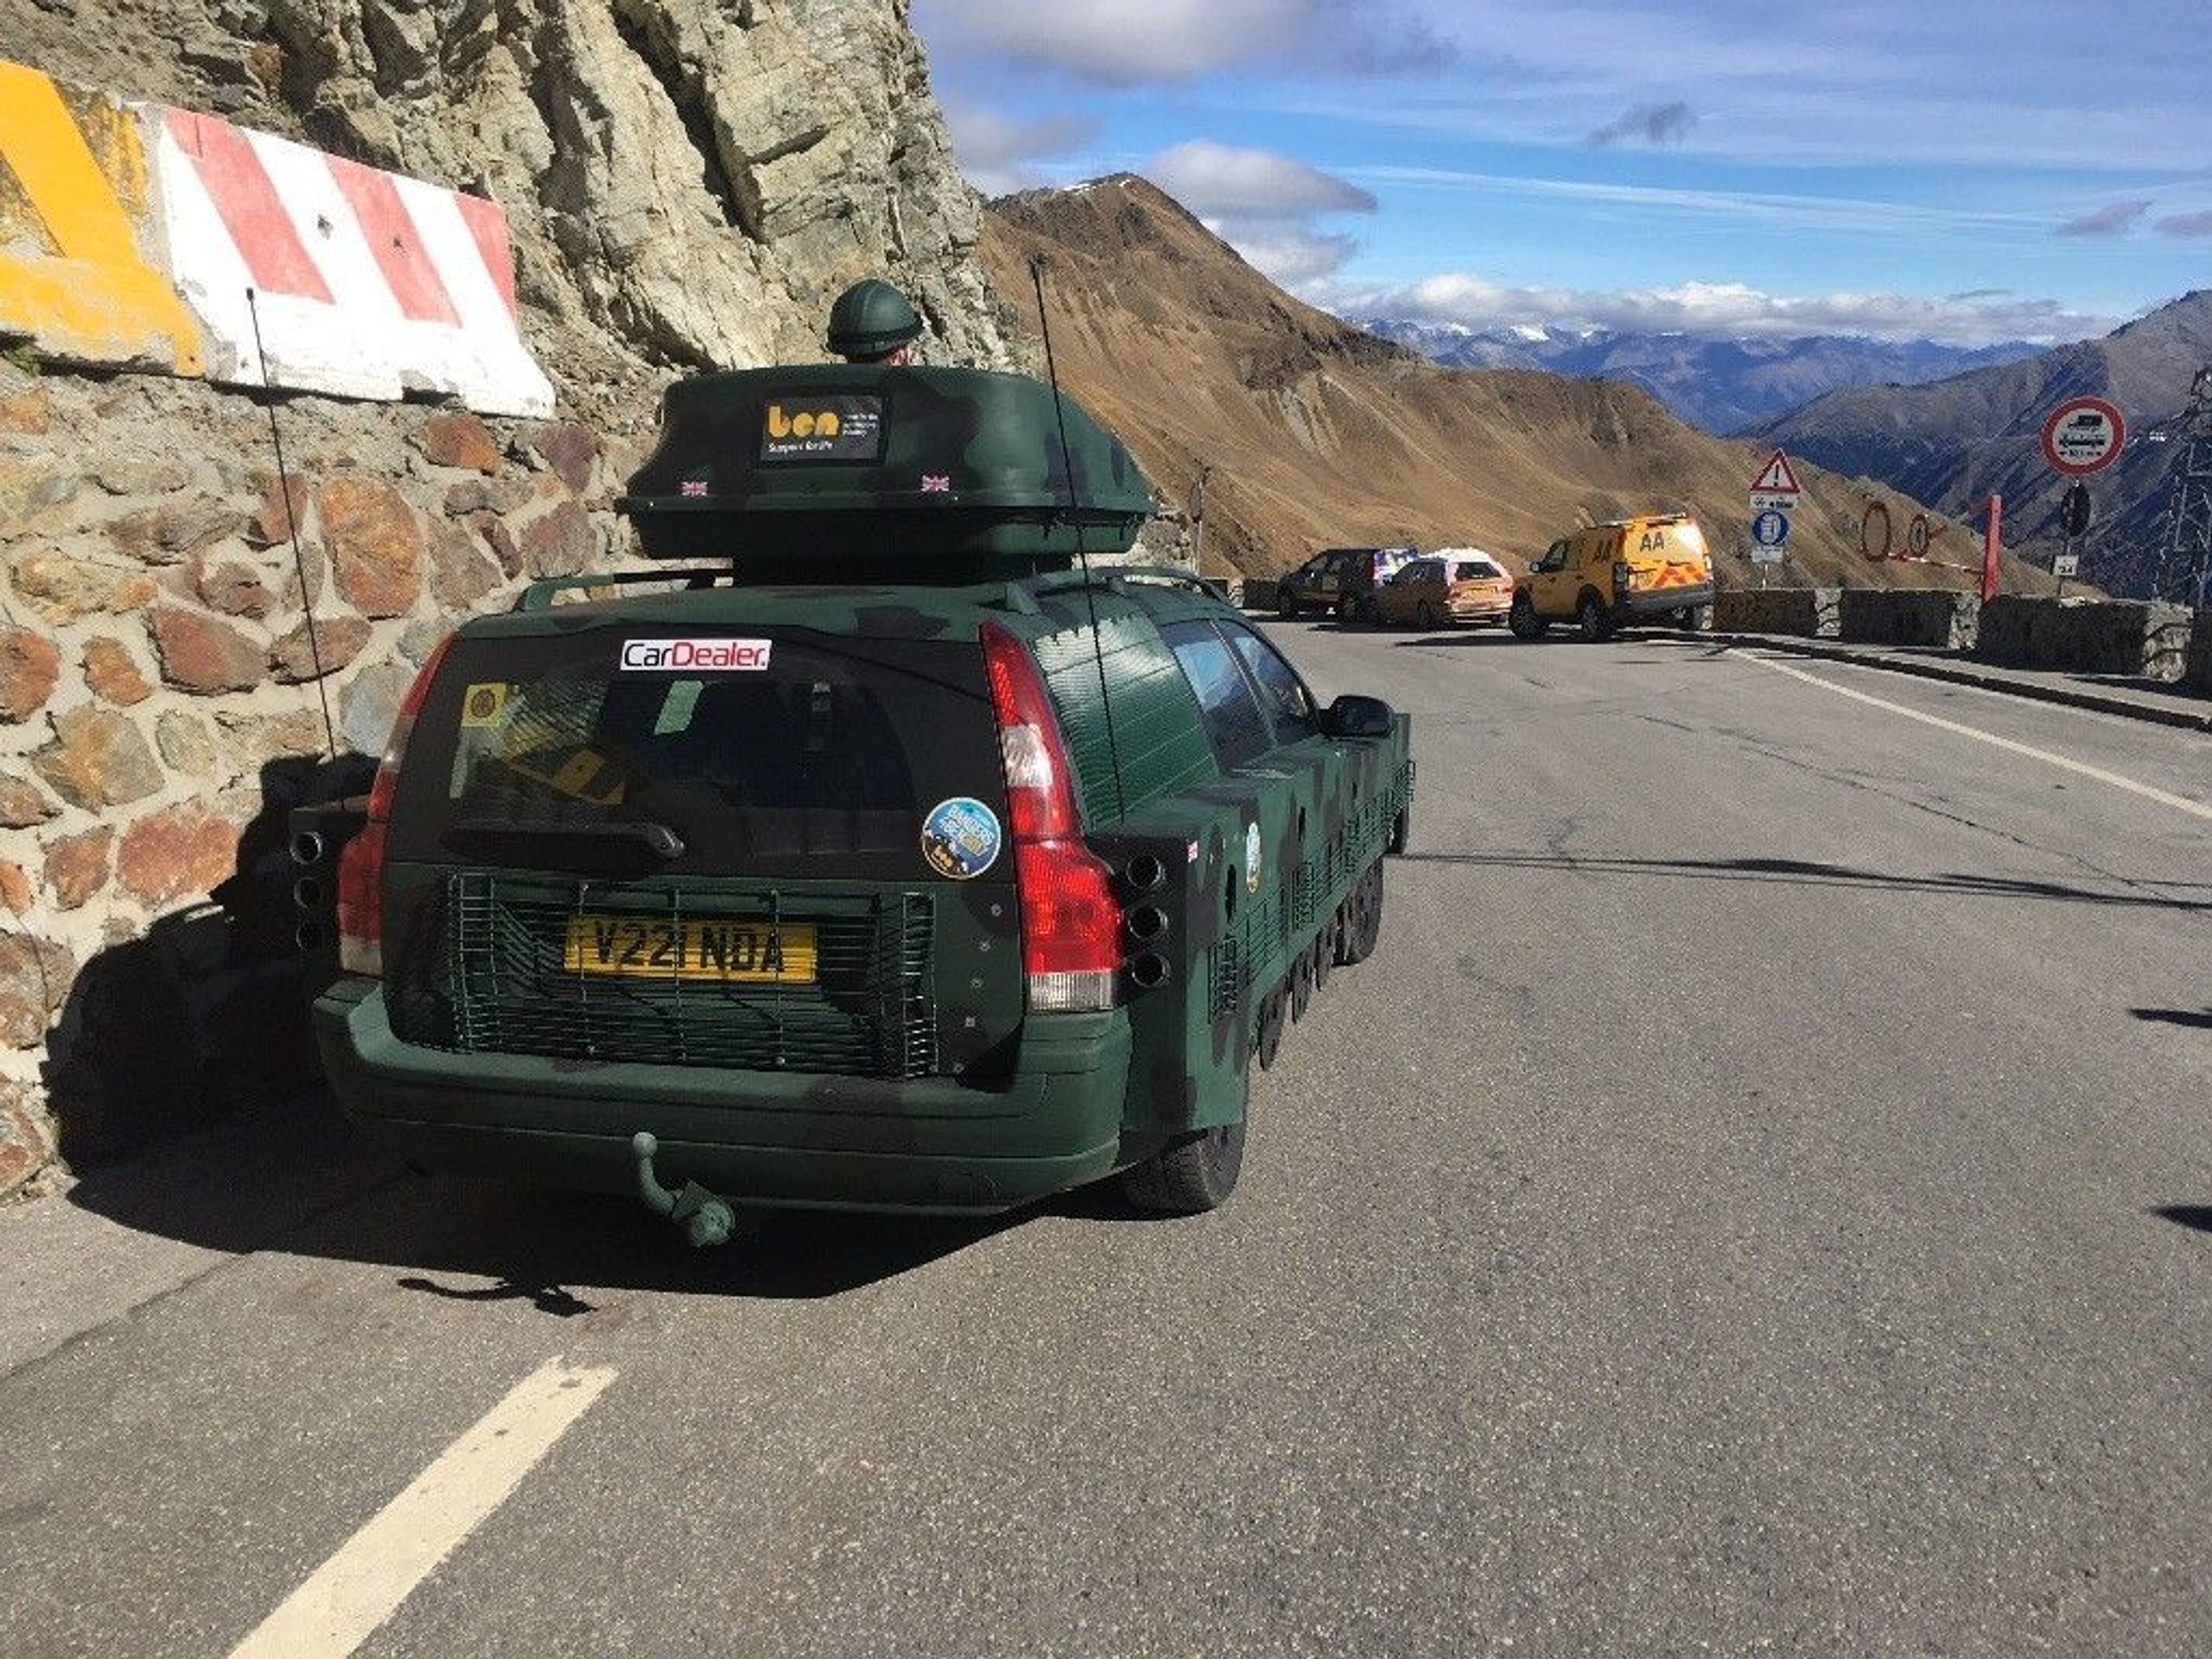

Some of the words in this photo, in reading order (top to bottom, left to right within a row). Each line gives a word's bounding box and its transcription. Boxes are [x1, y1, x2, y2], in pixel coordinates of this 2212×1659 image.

[768, 405, 840, 437] ben
[1639, 531, 1664, 552] AA
[594, 919, 689, 969] V221
[699, 925, 785, 973] NDA
